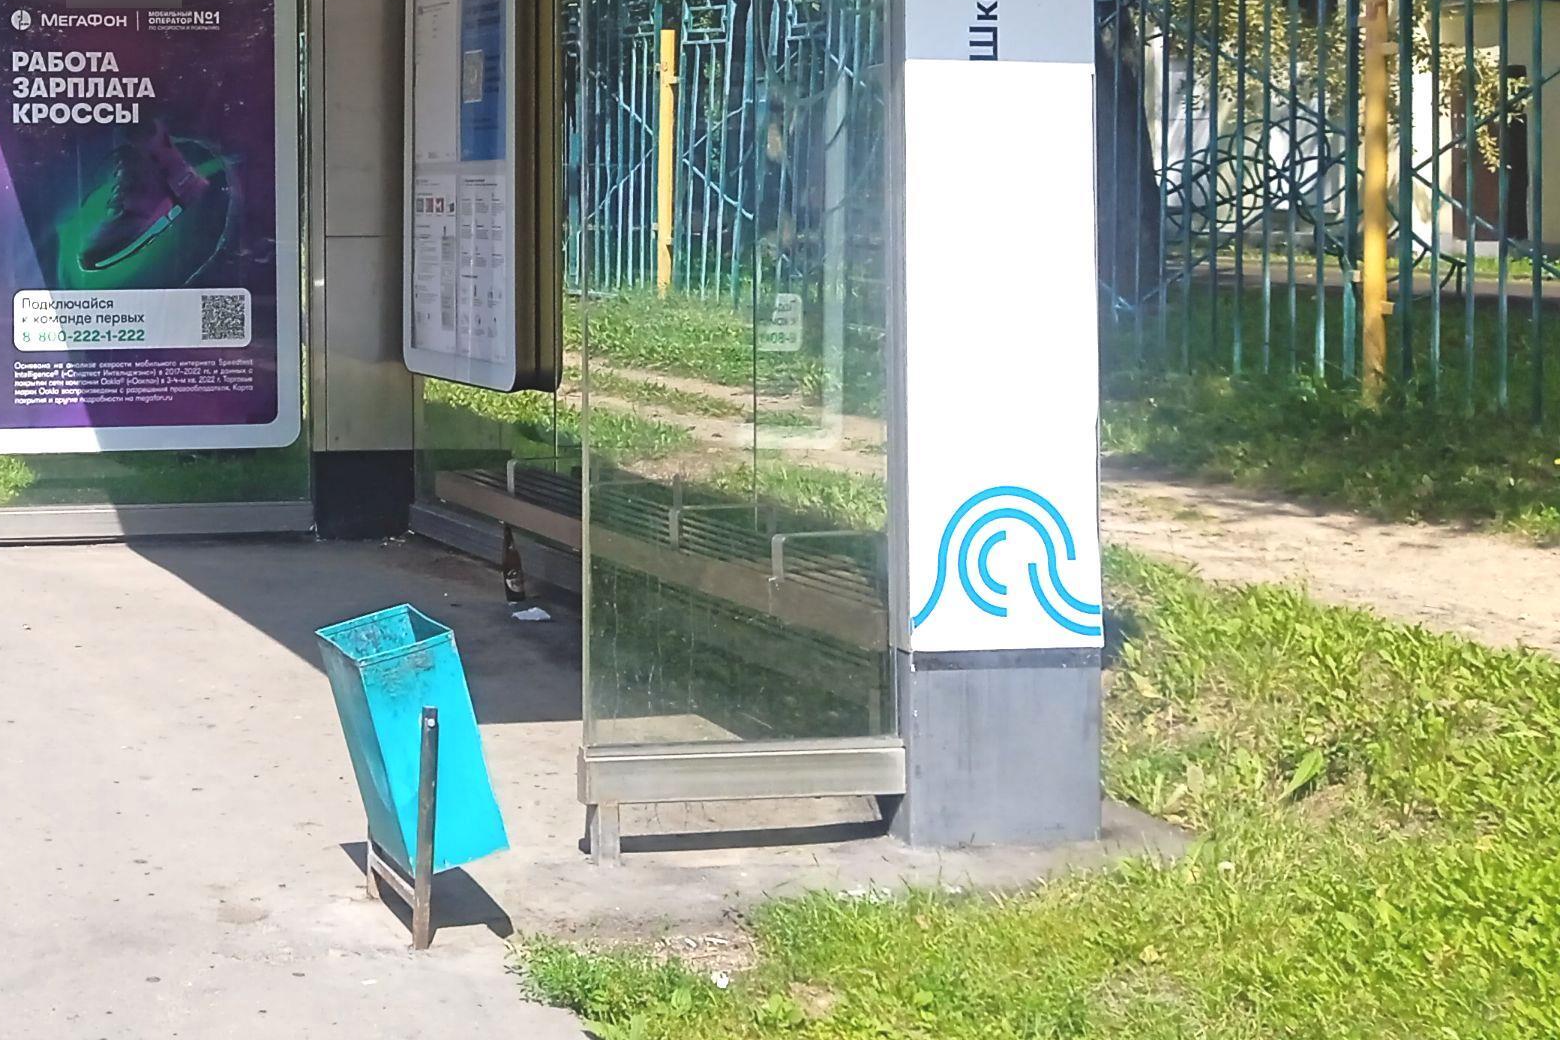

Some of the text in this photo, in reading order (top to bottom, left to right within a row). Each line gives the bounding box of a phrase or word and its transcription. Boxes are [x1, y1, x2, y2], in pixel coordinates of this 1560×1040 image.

[12, 51, 120, 72] РАБОТА
[12, 77, 156, 98] ЗАРПЛАТА
[12, 102, 140, 124] КРОССЫ
[22, 297, 114, 310] Подключайся
[95, 314, 145, 326] первых
[22, 332, 31, 342] 8
